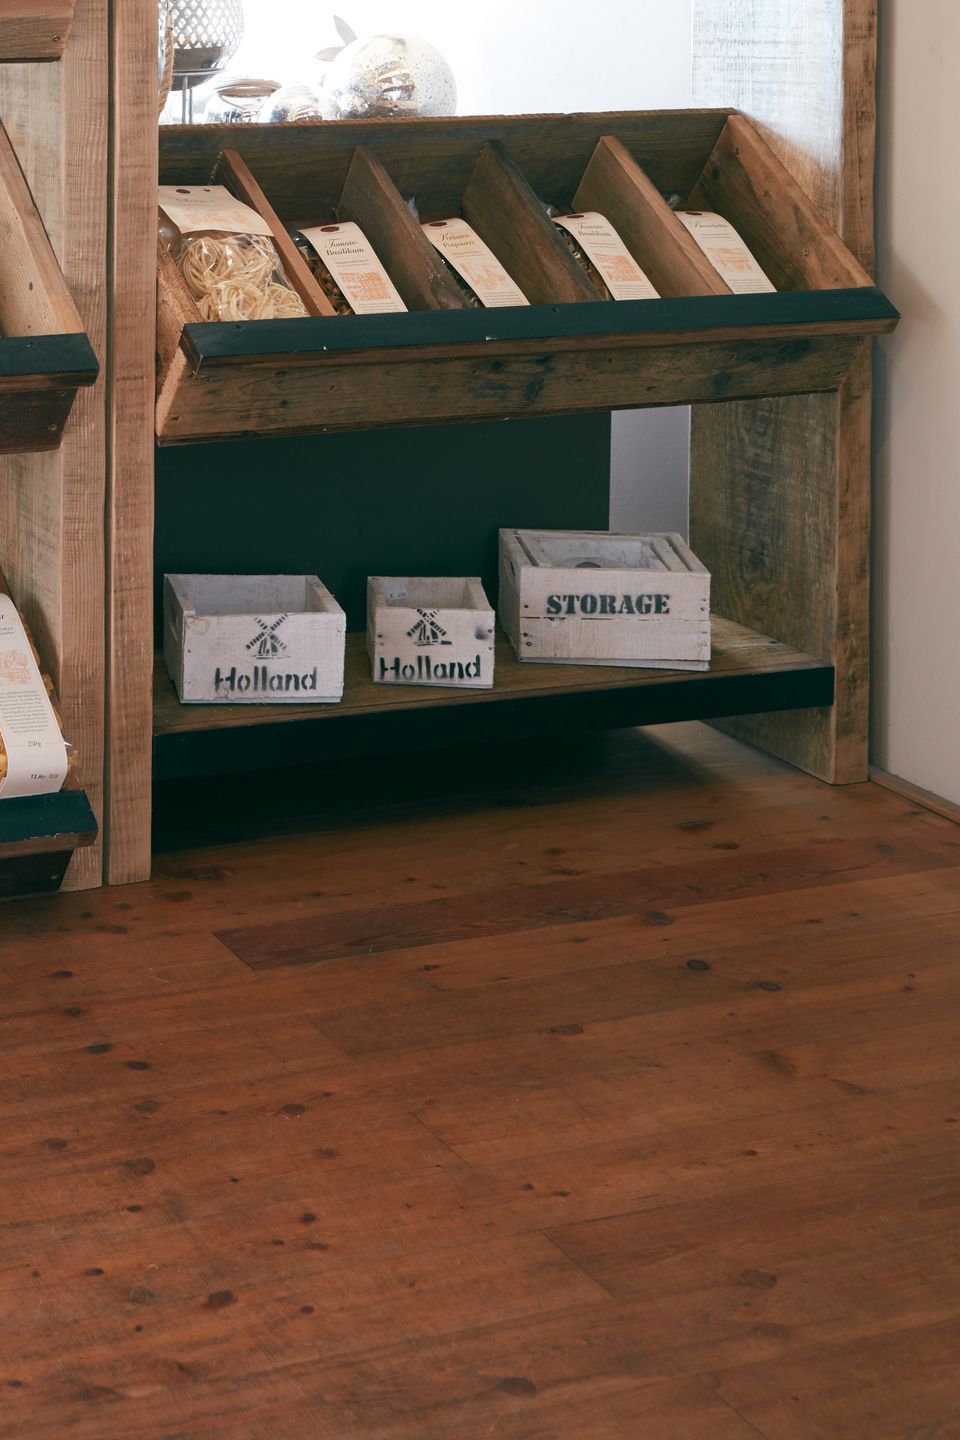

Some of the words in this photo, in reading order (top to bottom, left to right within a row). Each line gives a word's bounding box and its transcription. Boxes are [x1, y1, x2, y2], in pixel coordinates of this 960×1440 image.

[324, 237, 359, 249] Tomate-
[442, 240, 475, 249] Potpourri
[326, 247, 364, 257] Basilikum
[546, 593, 672, 615] STORAGE
[380, 654, 481, 681] Holland
[214, 666, 318, 692] Holland
